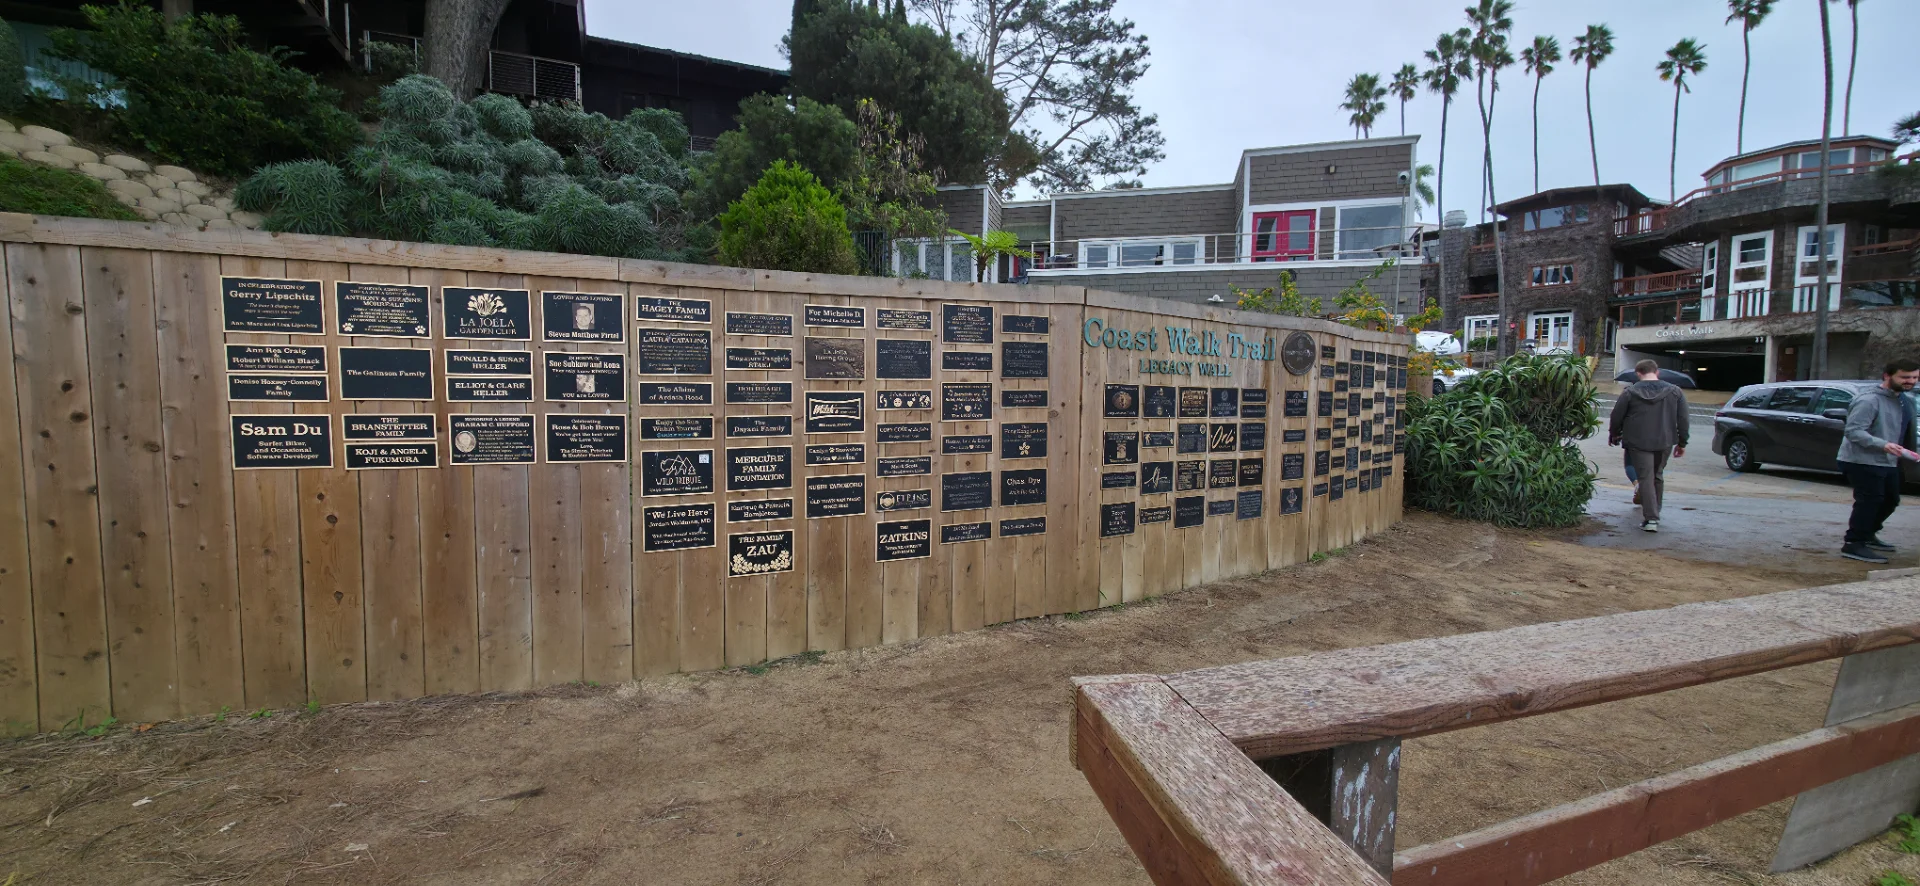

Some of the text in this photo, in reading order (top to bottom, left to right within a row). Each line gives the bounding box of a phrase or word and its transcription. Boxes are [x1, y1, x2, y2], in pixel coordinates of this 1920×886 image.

[229, 290, 315, 301] Gerry Lipschitz
[641, 304, 673, 313] HAGEY
[675, 306, 707, 316] FAMILY
[459, 317, 476, 327] LA
[548, 330, 570, 338] Steven
[571, 331, 600, 339] Matthew
[1655, 327, 1715, 339] Coast Walk
[1083, 317, 1276, 361] Coast Walk Trail
[283, 347, 307, 355] Craig
[589, 360, 602, 368] and
[1139, 359, 1233, 378] LEGACY WALL
[399, 370, 426, 378] Family
[240, 422, 322, 436] Sam Du
[760, 425, 785, 433] Family
[735, 455, 784, 464] MERCURE
[742, 464, 777, 473] FAMILY
[655, 475, 702, 486] WILD TRIBUTE
[734, 474, 785, 482] FOUNDATION
[667, 510, 686, 518] Live
[687, 508, 713, 517] Here"
[756, 534, 784, 542] FAMILY
[879, 531, 928, 544] ZATKINS
[746, 544, 777, 557] ZAU
